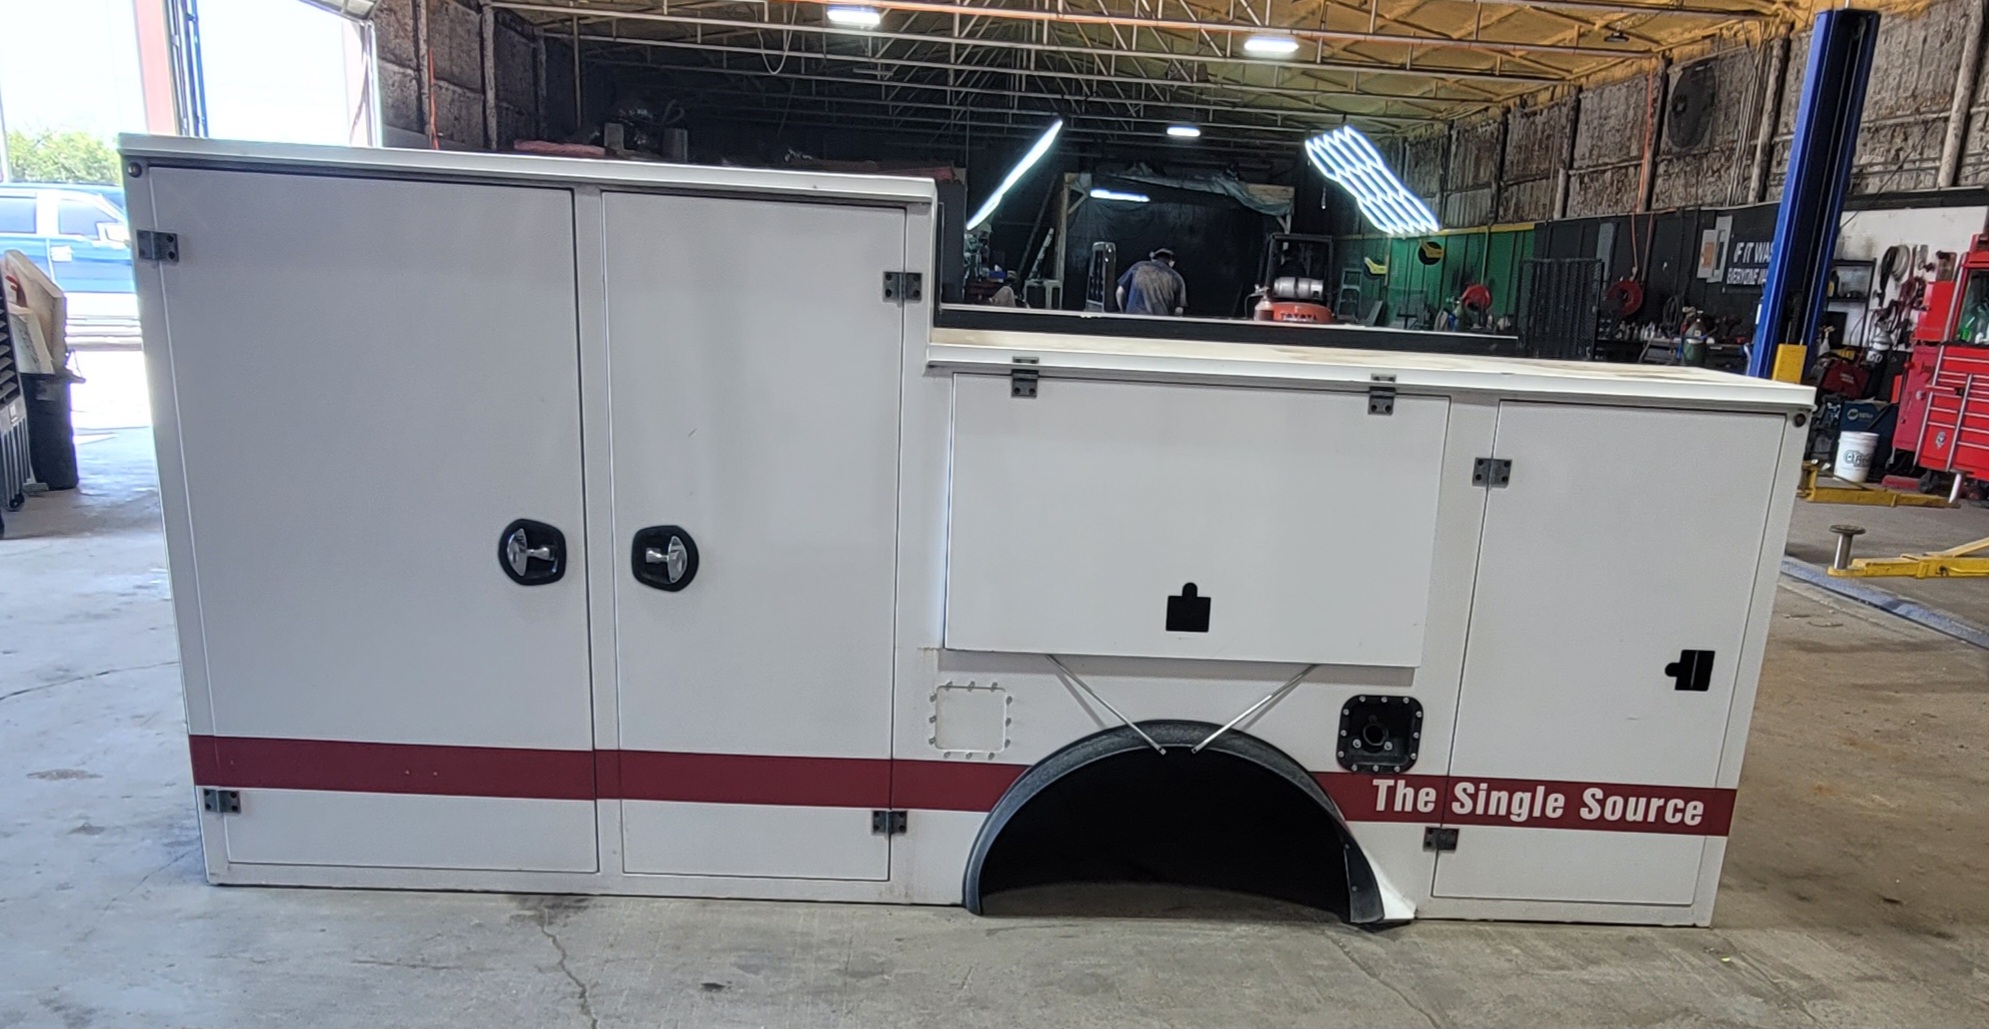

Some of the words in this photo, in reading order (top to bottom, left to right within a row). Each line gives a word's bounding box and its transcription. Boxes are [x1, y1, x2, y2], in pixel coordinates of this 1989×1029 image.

[1742, 242, 1755, 264] IT
[1280, 312, 1318, 321] TOYOTA
[1372, 778, 1436, 813] The
[1451, 781, 1566, 822] Single
[1579, 787, 1704, 826] Source
